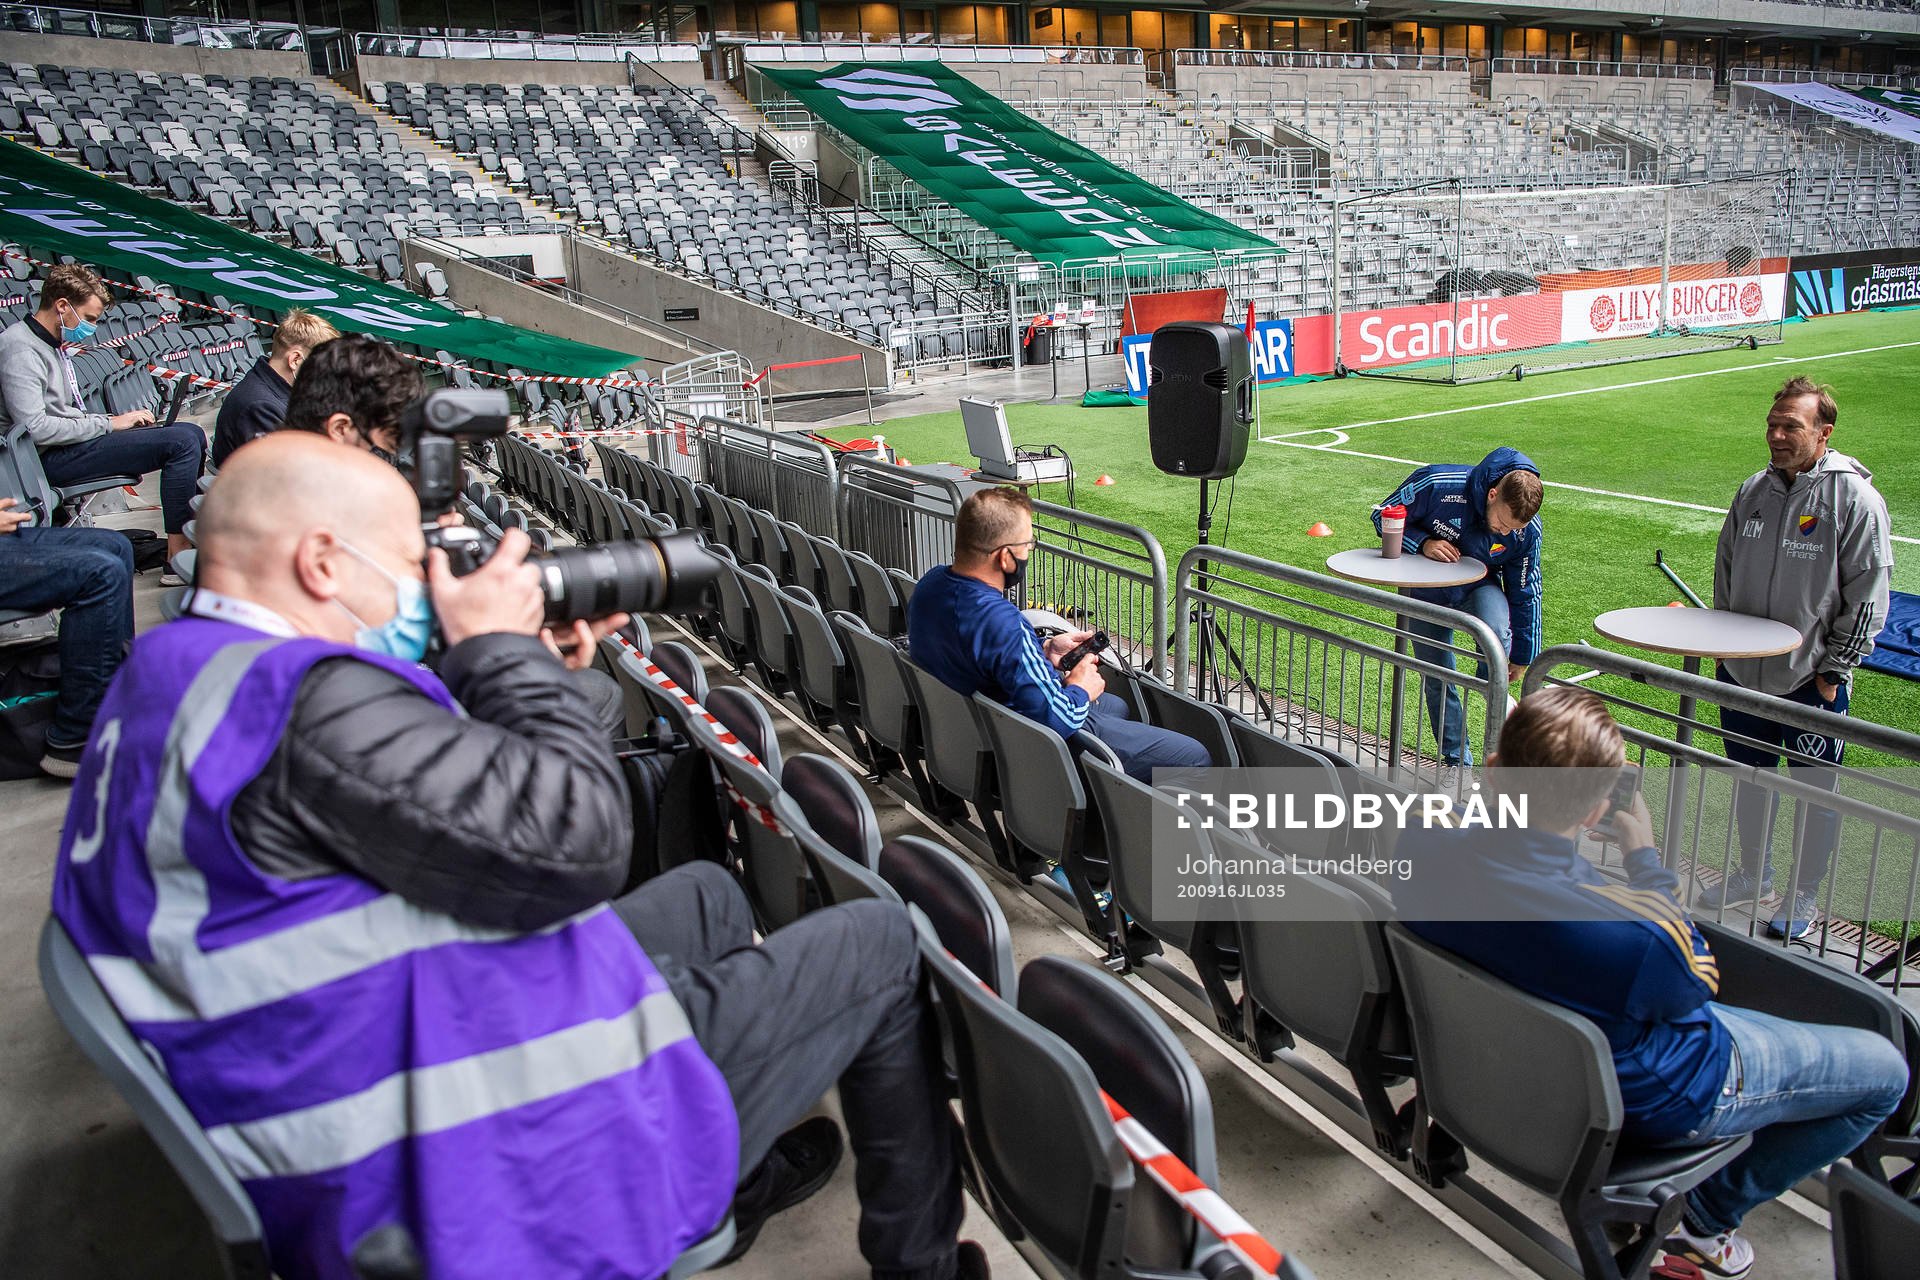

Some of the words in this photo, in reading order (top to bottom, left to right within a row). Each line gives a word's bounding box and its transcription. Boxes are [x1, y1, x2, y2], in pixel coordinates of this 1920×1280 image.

[785, 135, 808, 149] 119
[1672, 282, 1738, 316] BURGER
[1359, 302, 1509, 363] Scandic
[1432, 519, 1461, 540] Prioritet
[1782, 538, 1824, 553] Prioritet
[1786, 548, 1817, 561] Finans
